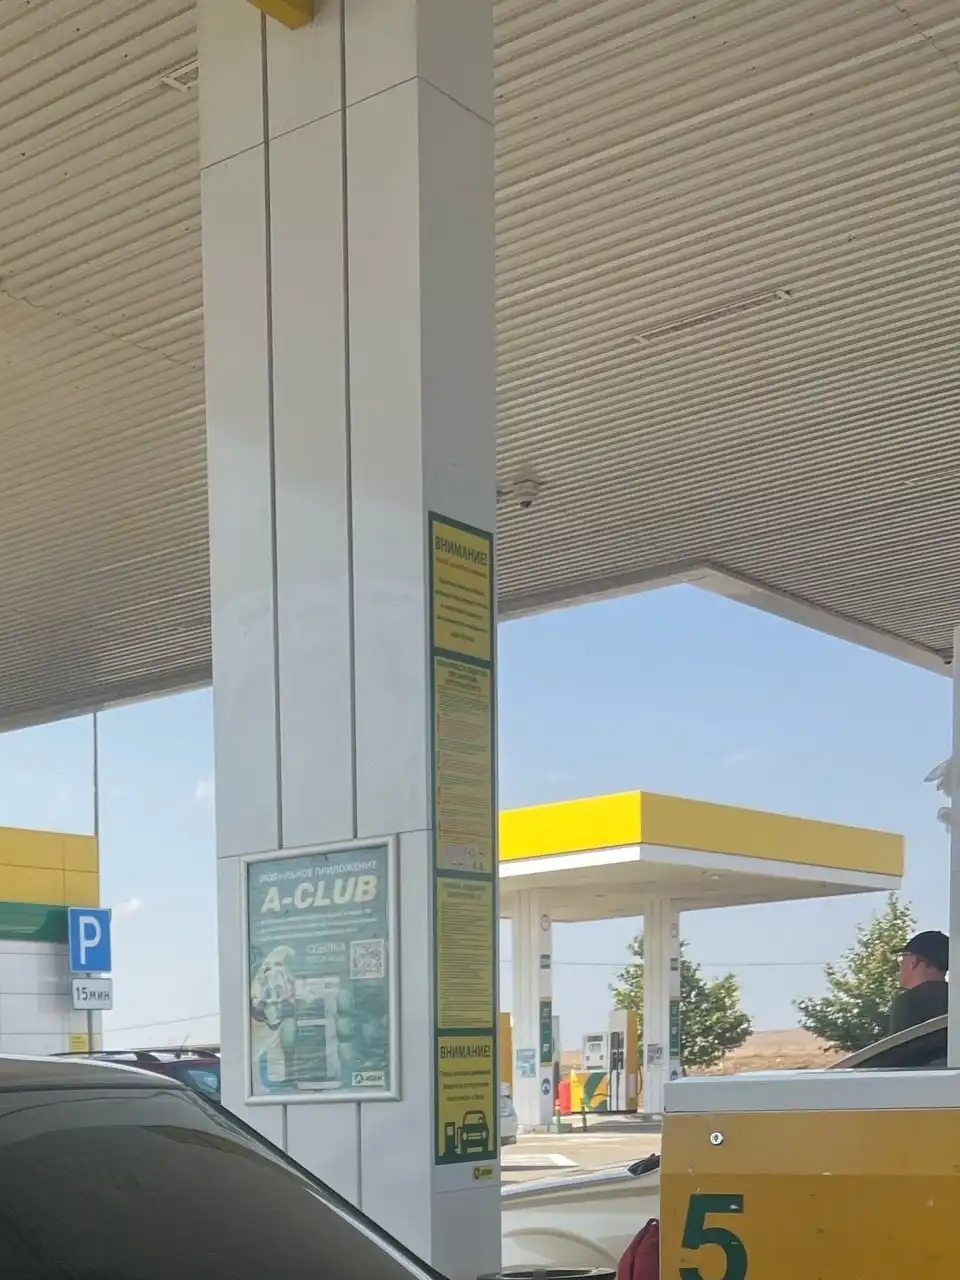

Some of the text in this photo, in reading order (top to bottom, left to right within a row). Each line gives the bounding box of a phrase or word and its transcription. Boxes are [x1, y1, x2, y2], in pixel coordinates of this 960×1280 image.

[435, 535, 488, 566] ВНИМАНИЕ!
[261, 875, 378, 913] A-CLUB
[79, 916, 102, 965] P
[440, 1043, 492, 1059] ВНИМАНИЕ!
